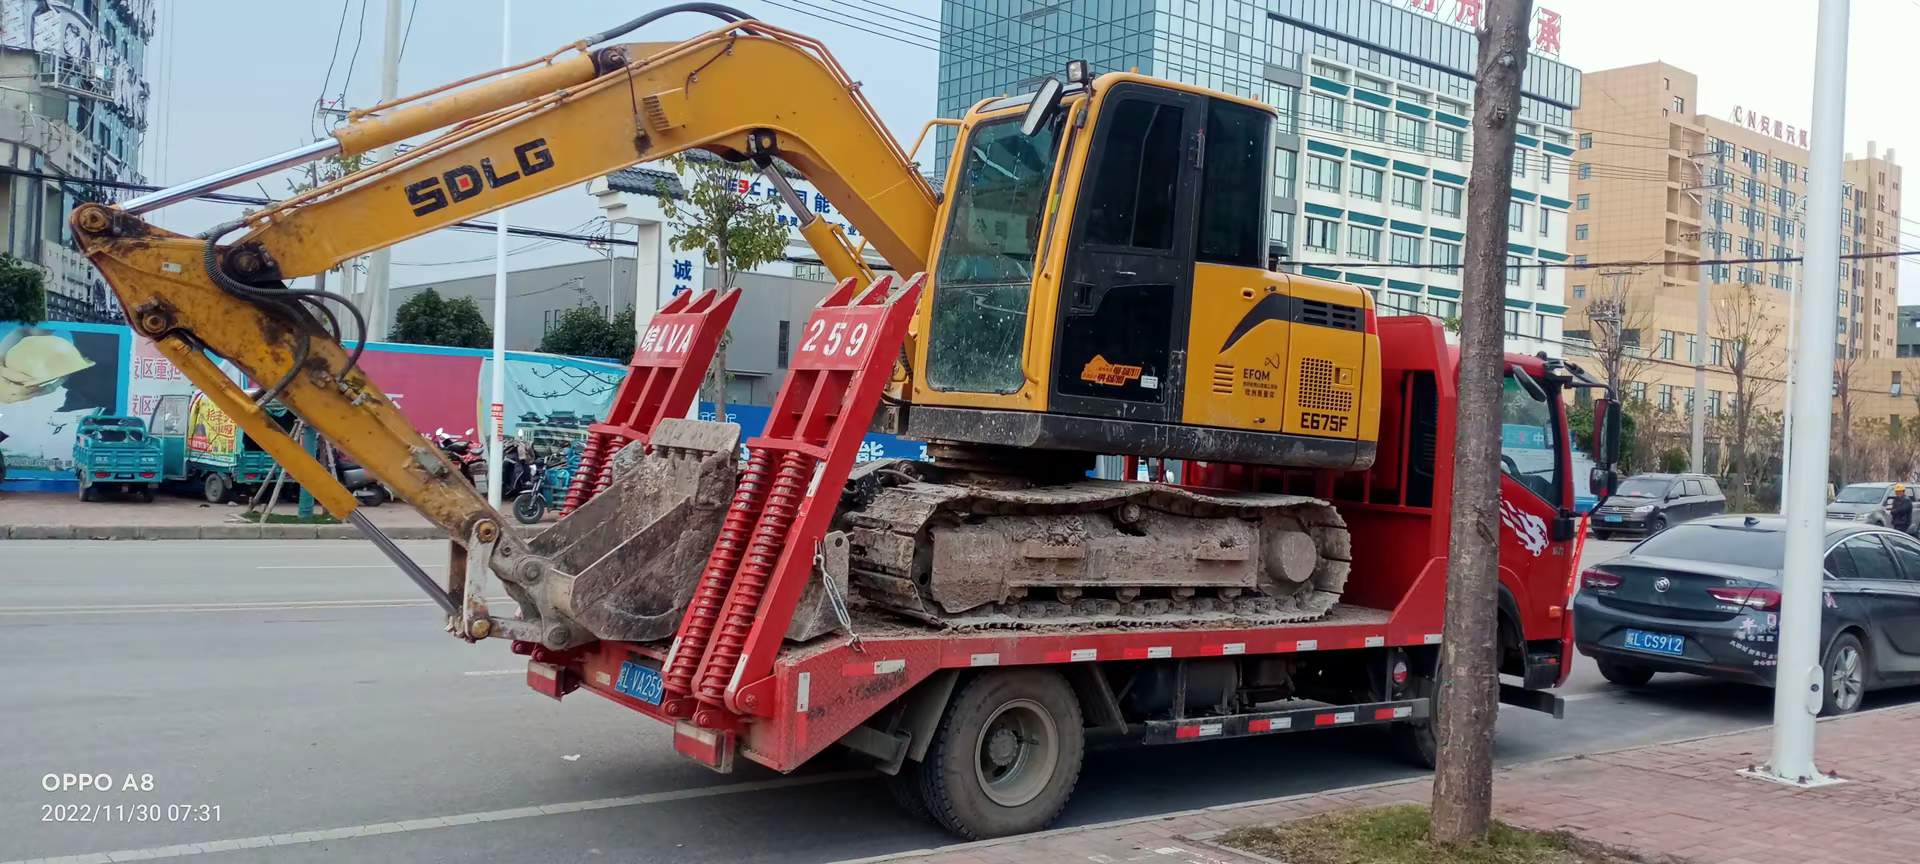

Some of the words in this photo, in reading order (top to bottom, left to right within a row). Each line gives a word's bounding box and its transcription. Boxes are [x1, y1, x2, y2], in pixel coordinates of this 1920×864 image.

[404, 137, 555, 217] SDLG
[801, 319, 868, 356] 259
[1243, 367, 1270, 382] EFQM
[1301, 411, 1348, 433] E675F
